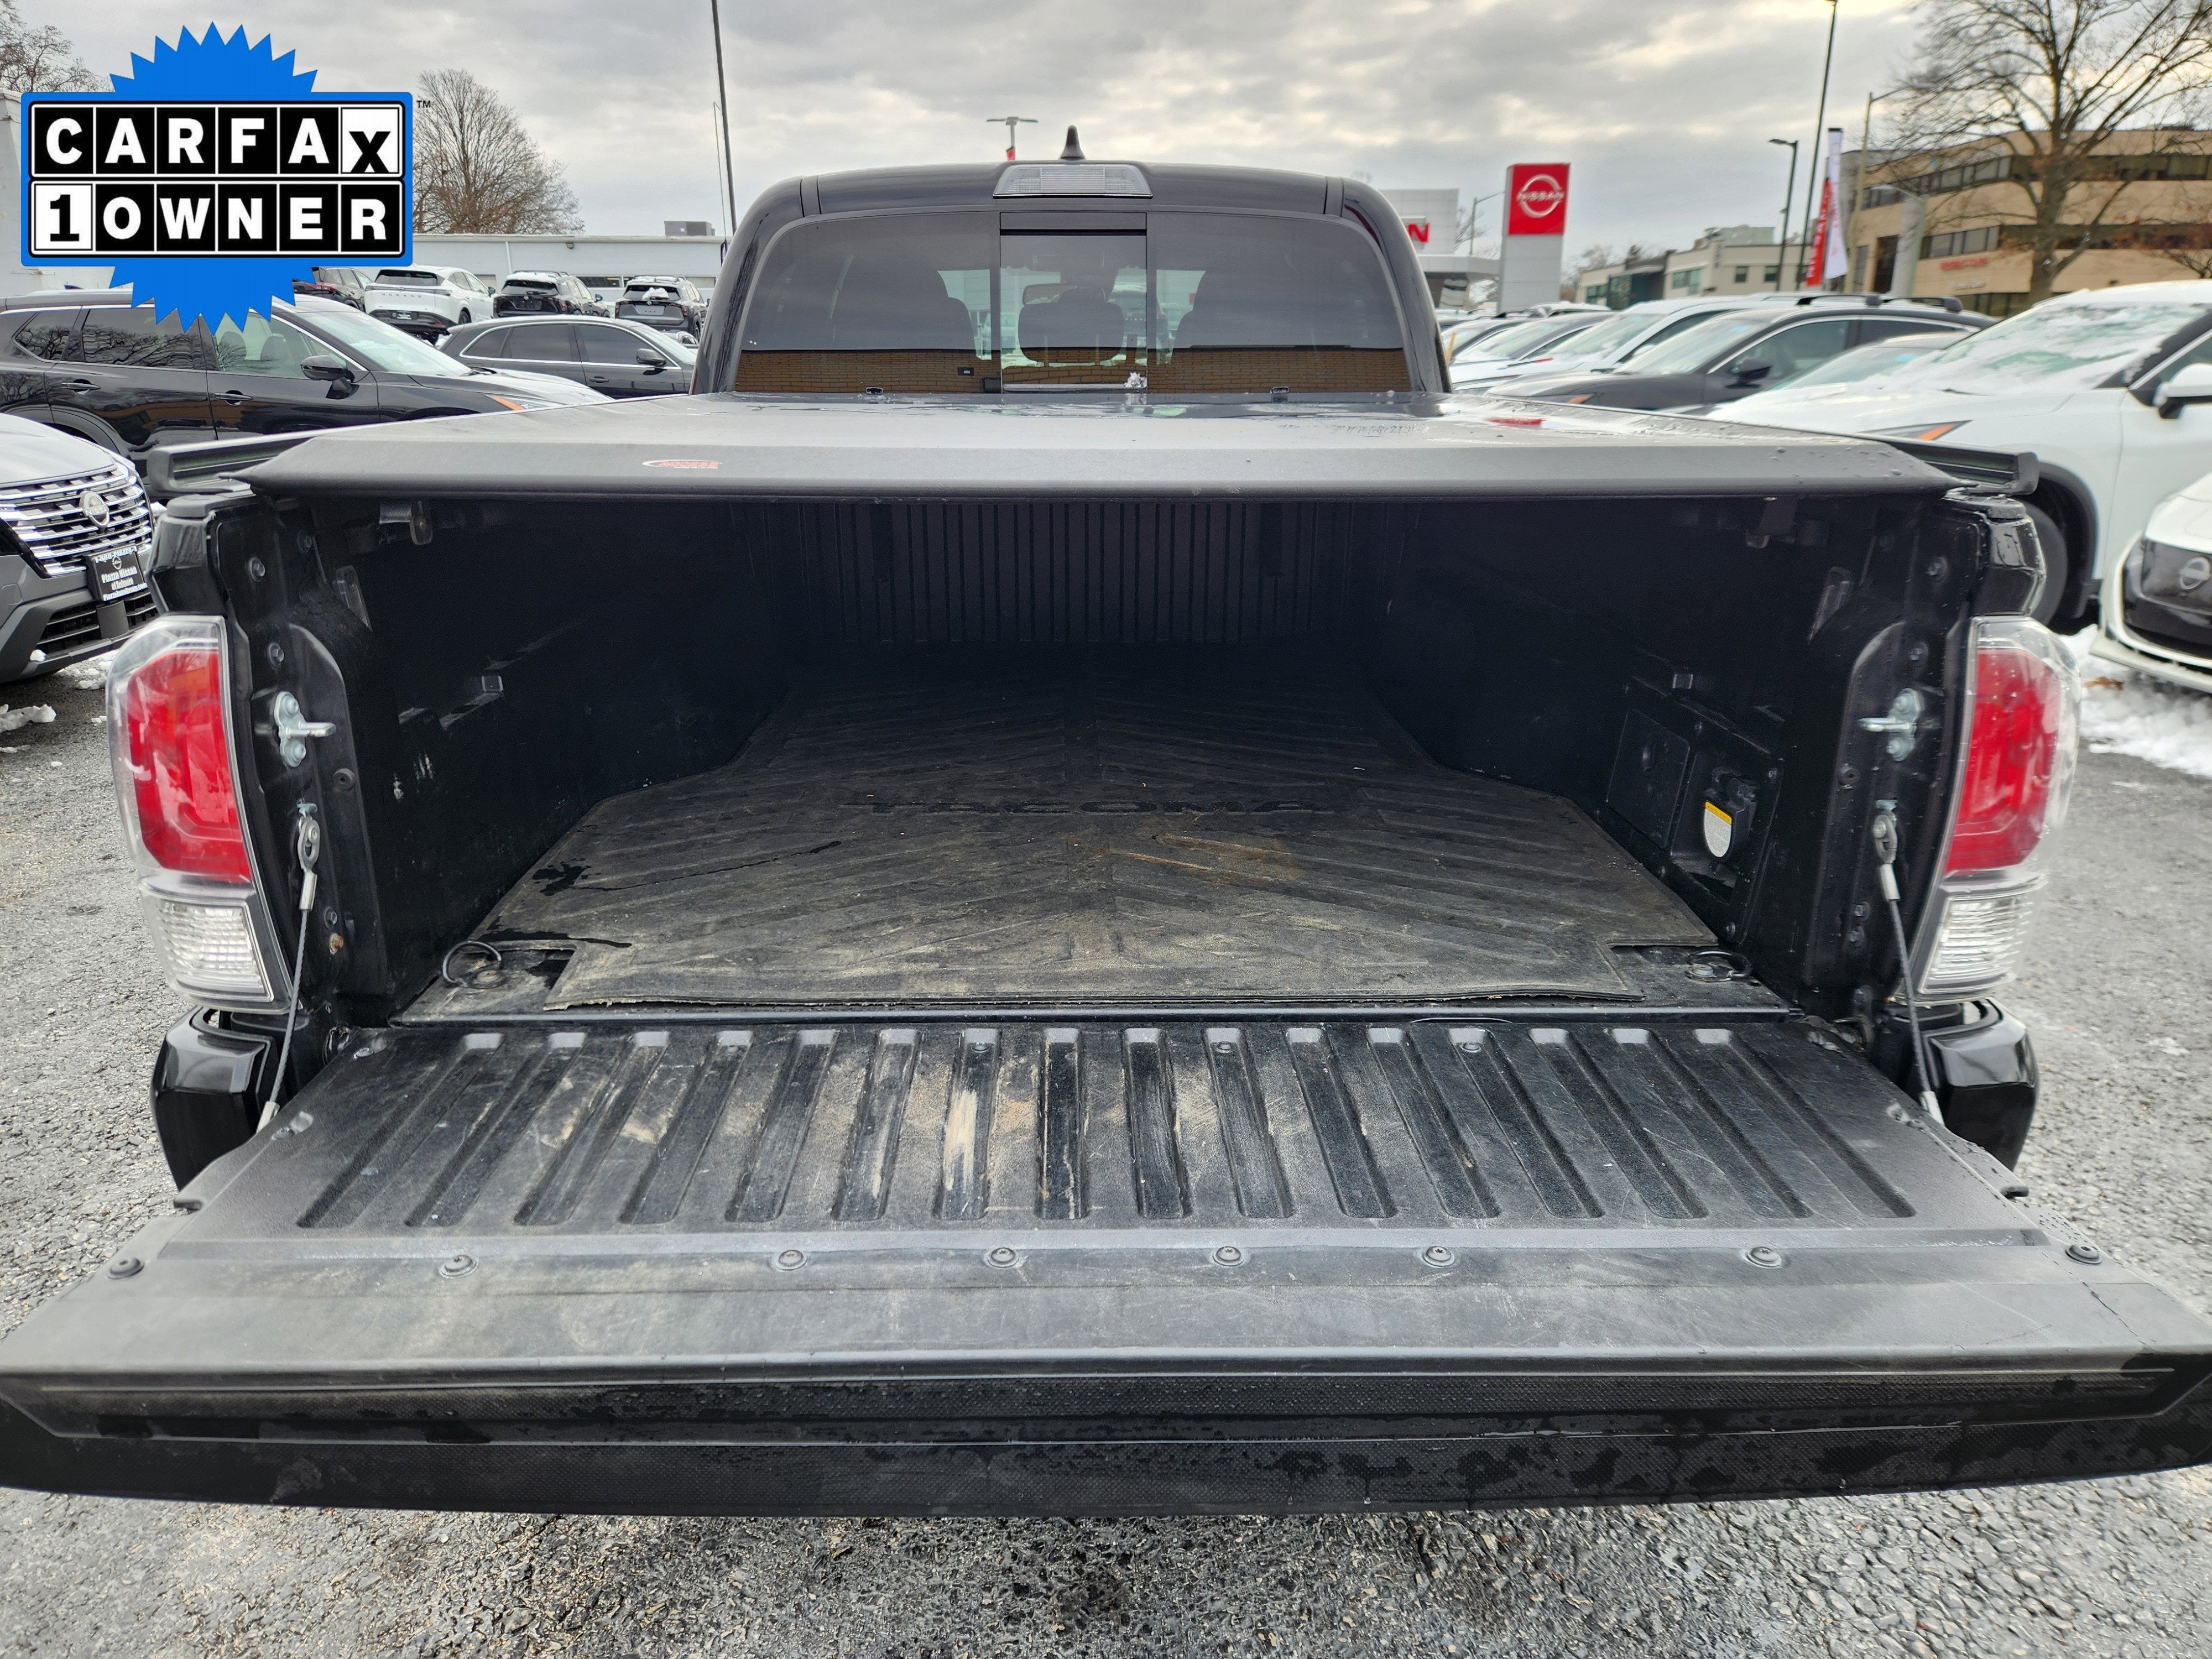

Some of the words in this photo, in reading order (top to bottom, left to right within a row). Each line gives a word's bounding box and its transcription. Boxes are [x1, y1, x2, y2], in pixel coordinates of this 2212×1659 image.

[1516, 191, 1564, 201] NISSAN
[119, 566, 137, 578] Nissan
[839, 800, 1336, 816] TACOMA
